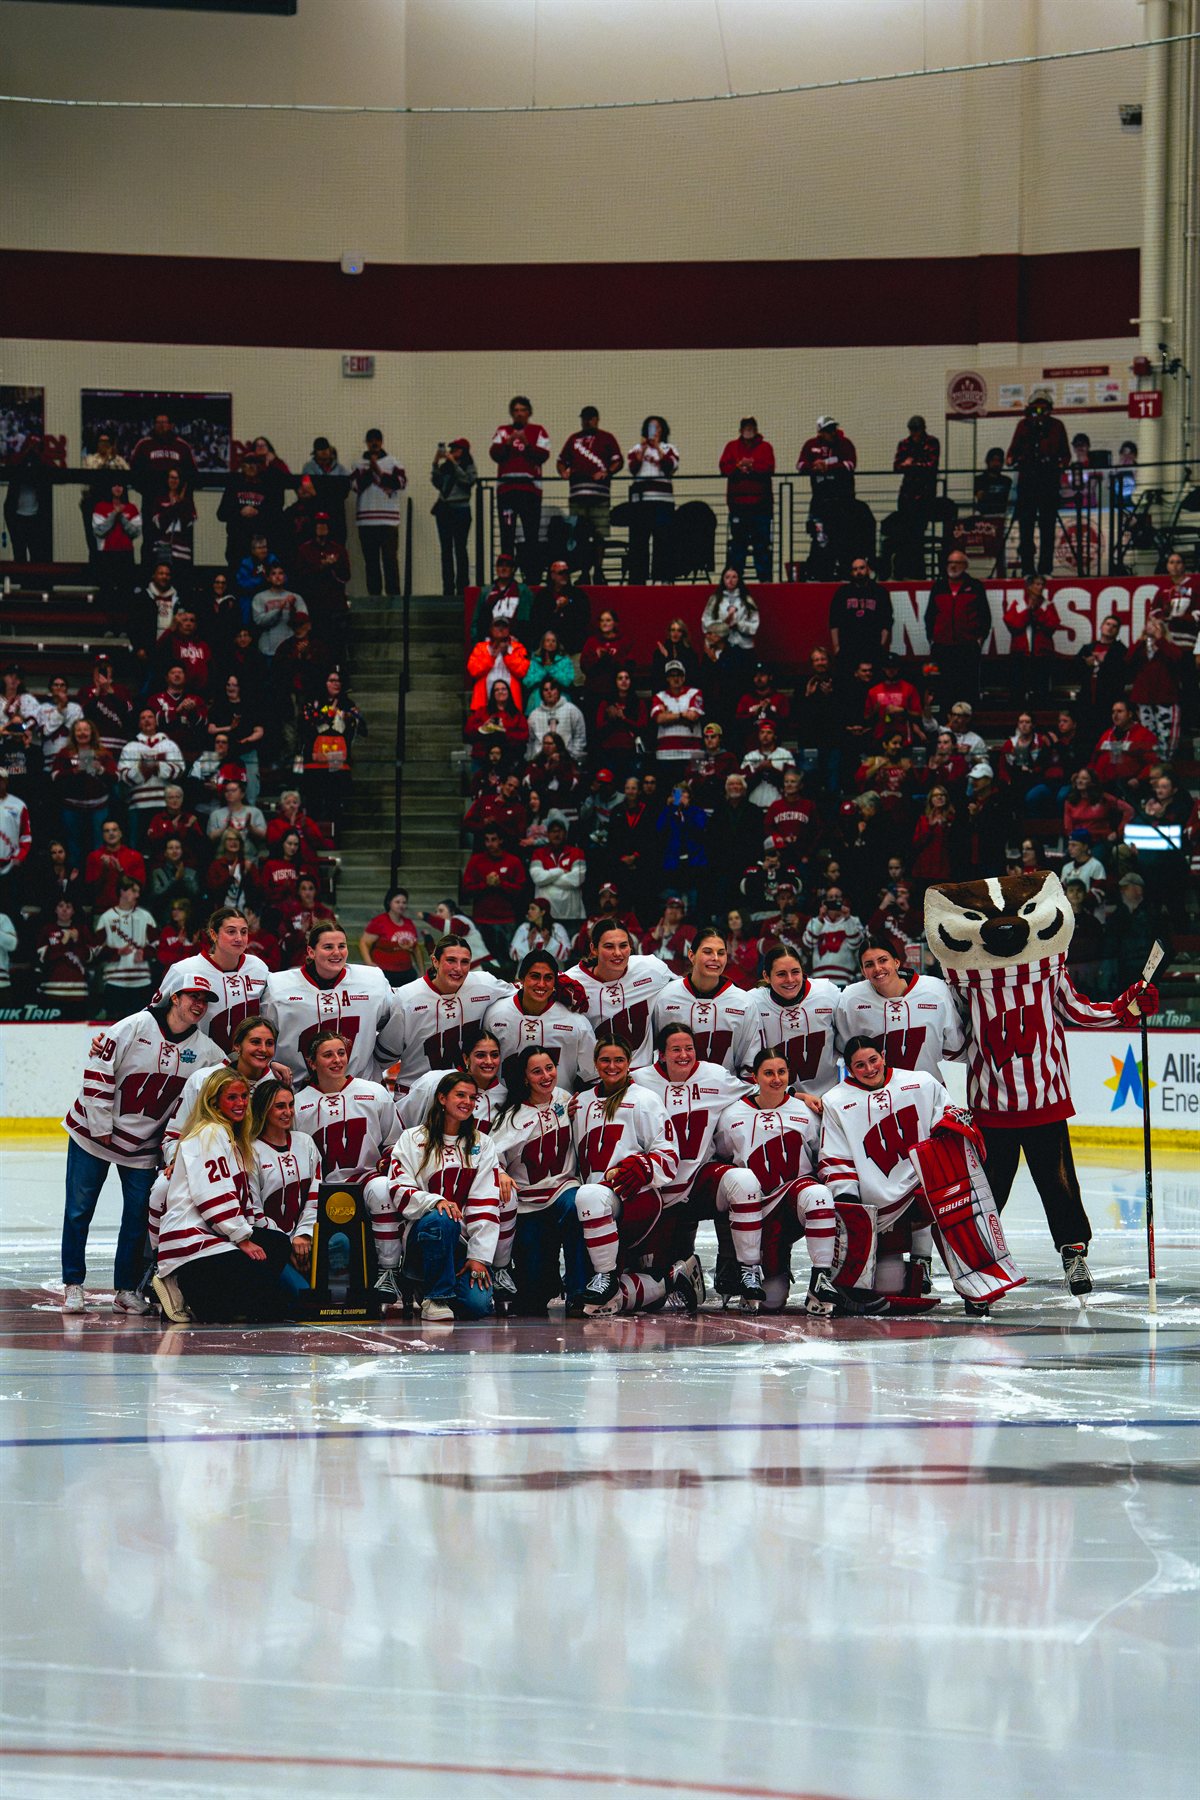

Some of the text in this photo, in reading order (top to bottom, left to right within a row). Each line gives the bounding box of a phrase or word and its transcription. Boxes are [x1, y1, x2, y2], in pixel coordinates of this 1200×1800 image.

[350, 356, 370, 372] EXIT
[1138, 401, 1154, 417] 11
[244, 974, 253, 991] A
[342, 990, 351, 1007] A
[984, 1004, 1040, 1073] W
[118, 1072, 188, 1120] W
[692, 1083, 701, 1100] A
[863, 1104, 920, 1178] W
[521, 1125, 570, 1185] W
[747, 1130, 803, 1196] W
[204, 1156, 231, 1184] 20
[939, 1196, 970, 1214] BAUER
